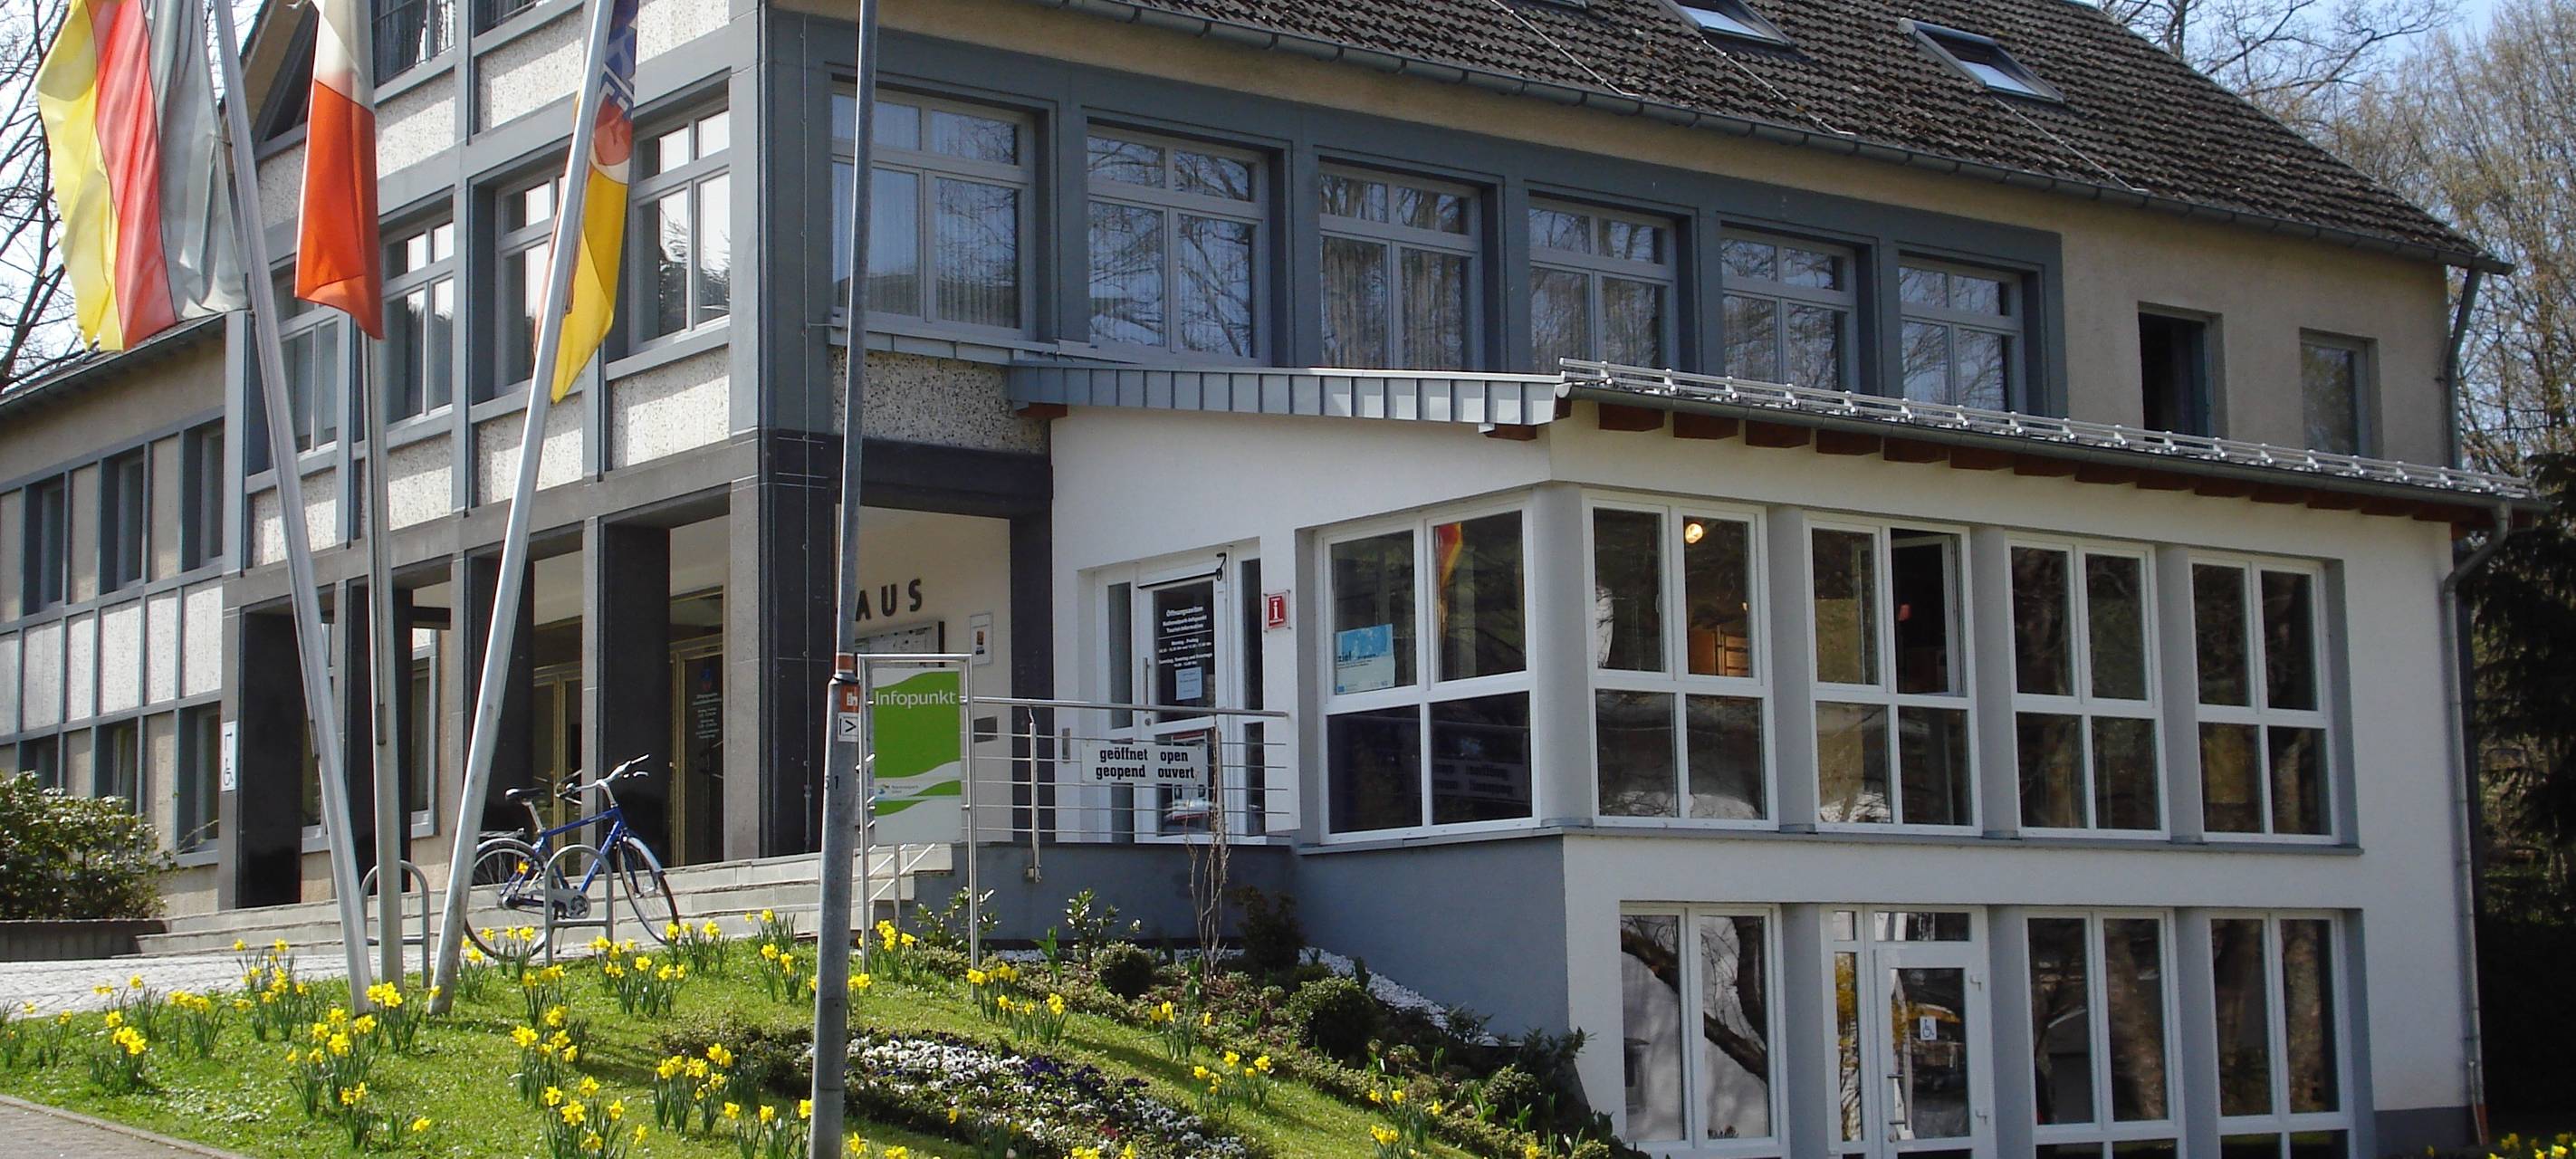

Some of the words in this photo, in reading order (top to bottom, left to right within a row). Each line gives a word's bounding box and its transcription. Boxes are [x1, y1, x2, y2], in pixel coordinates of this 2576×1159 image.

[856, 579, 923, 622] AUS
[875, 689, 956, 709] Infopunkt
[1100, 747, 1148, 762] geöffnet
[1160, 751, 1188, 764] open
[1096, 764, 1146, 780] geopend
[1157, 767, 1194, 779] ouvert
